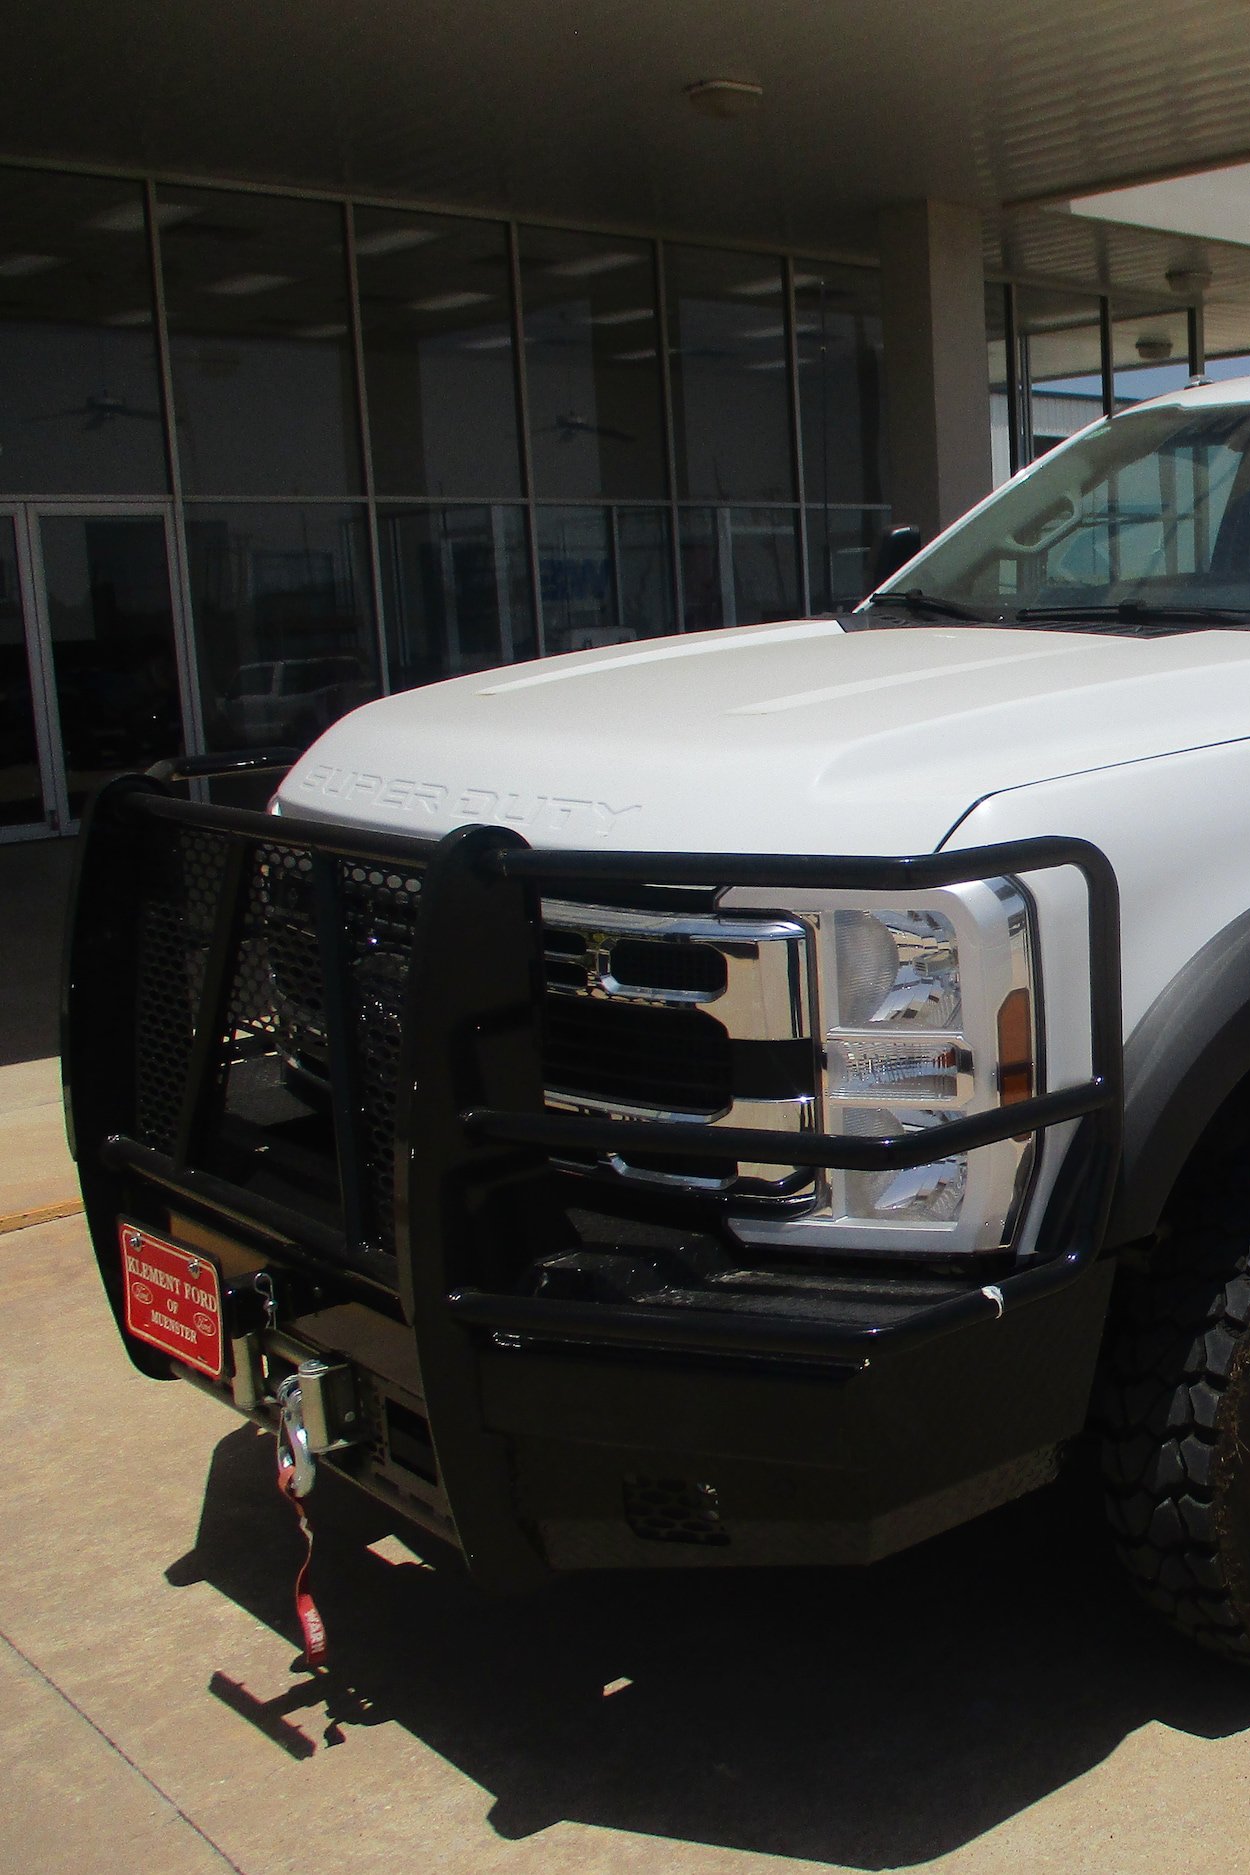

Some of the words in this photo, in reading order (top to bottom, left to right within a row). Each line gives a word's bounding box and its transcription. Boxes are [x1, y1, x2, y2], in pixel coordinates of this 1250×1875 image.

[302, 764, 449, 814] SUPER
[450, 787, 643, 838] DUTY
[127, 1256, 181, 1295] KLEMENT
[184, 1281, 217, 1313] FORD
[167, 1299, 178, 1314] OF
[151, 1309, 197, 1344] MUENSTER
